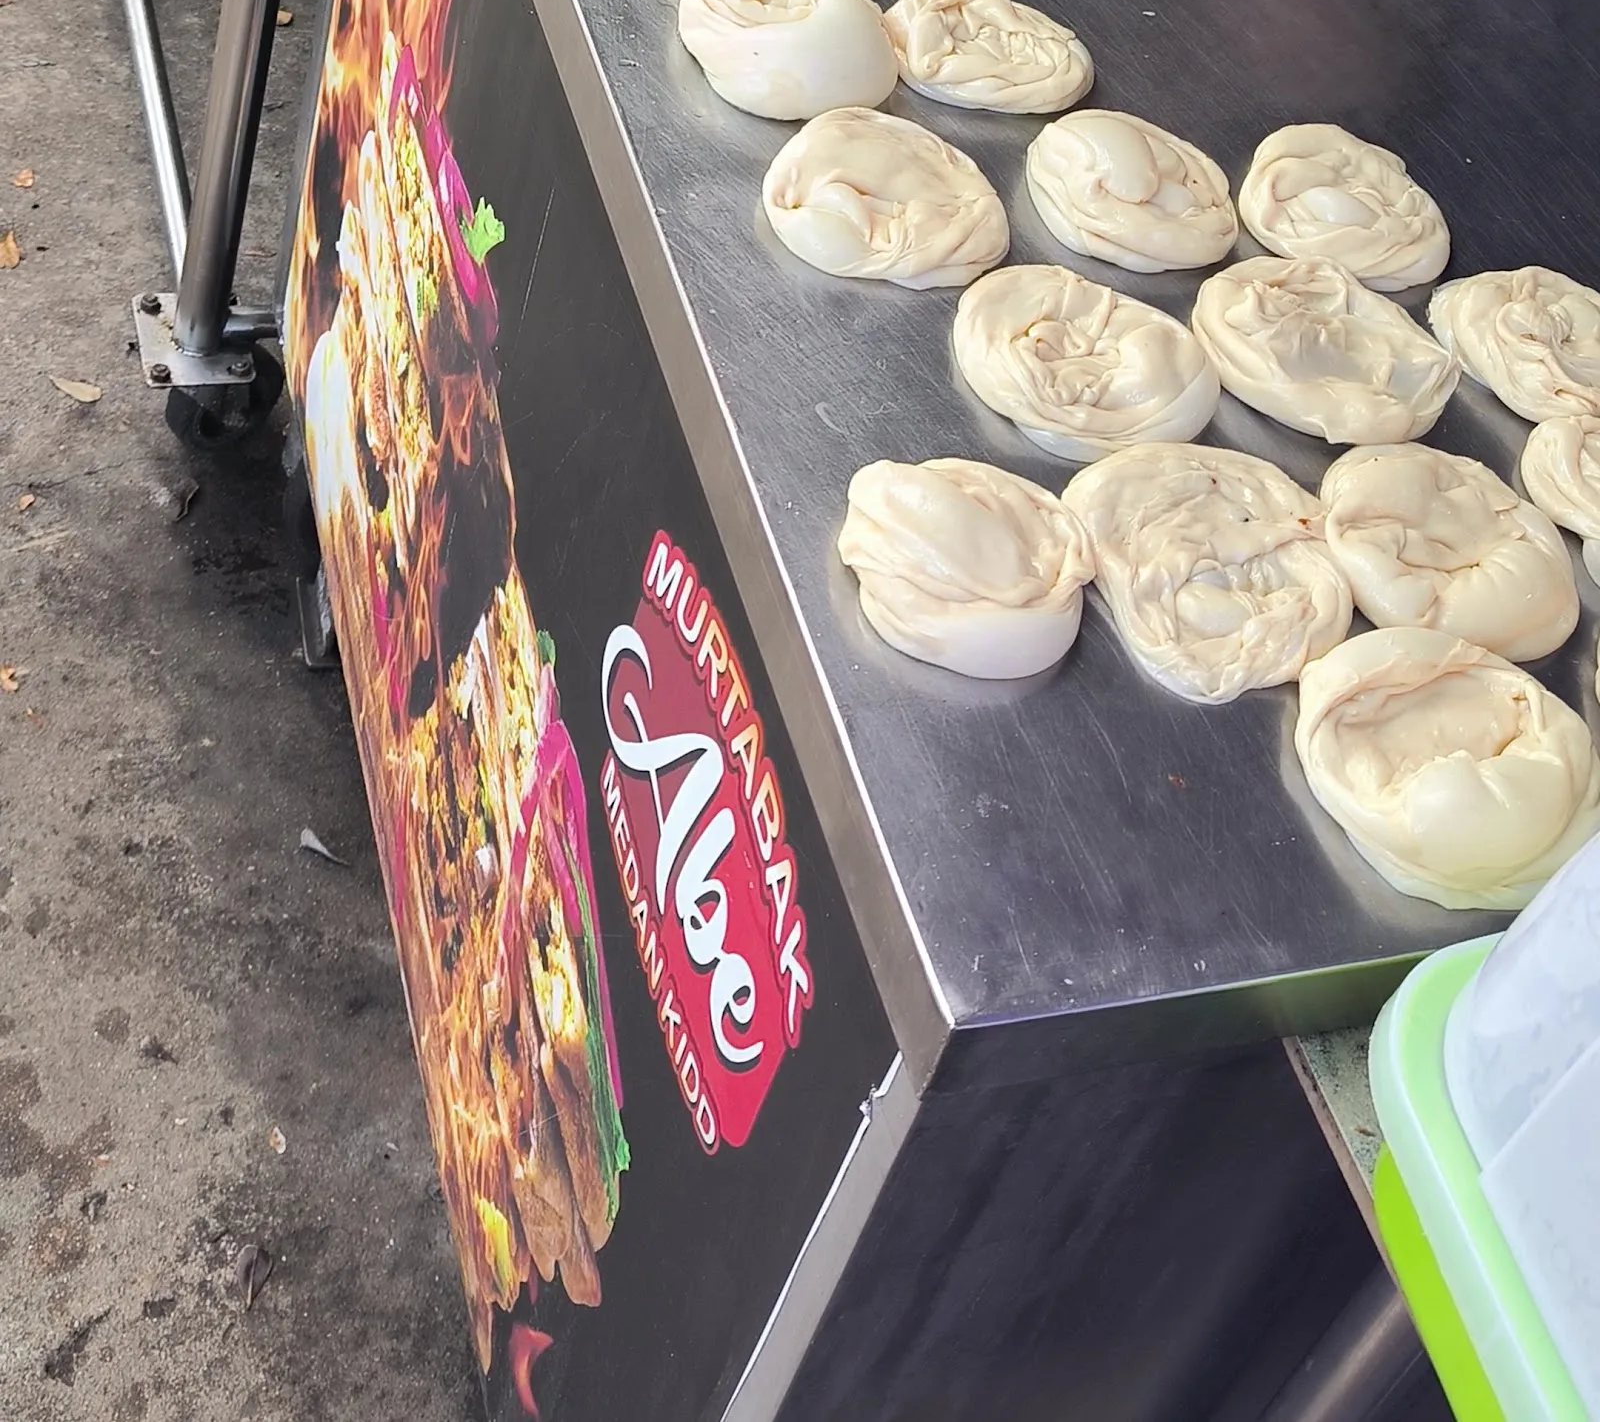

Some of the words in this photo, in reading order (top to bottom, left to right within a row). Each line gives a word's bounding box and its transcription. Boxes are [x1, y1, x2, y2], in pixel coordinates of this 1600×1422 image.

[602, 625, 764, 1063] Abe
[604, 757, 664, 990] MEDAN
[661, 990, 715, 1145] KIDD
[648, 541, 809, 1034] MURTABAK
